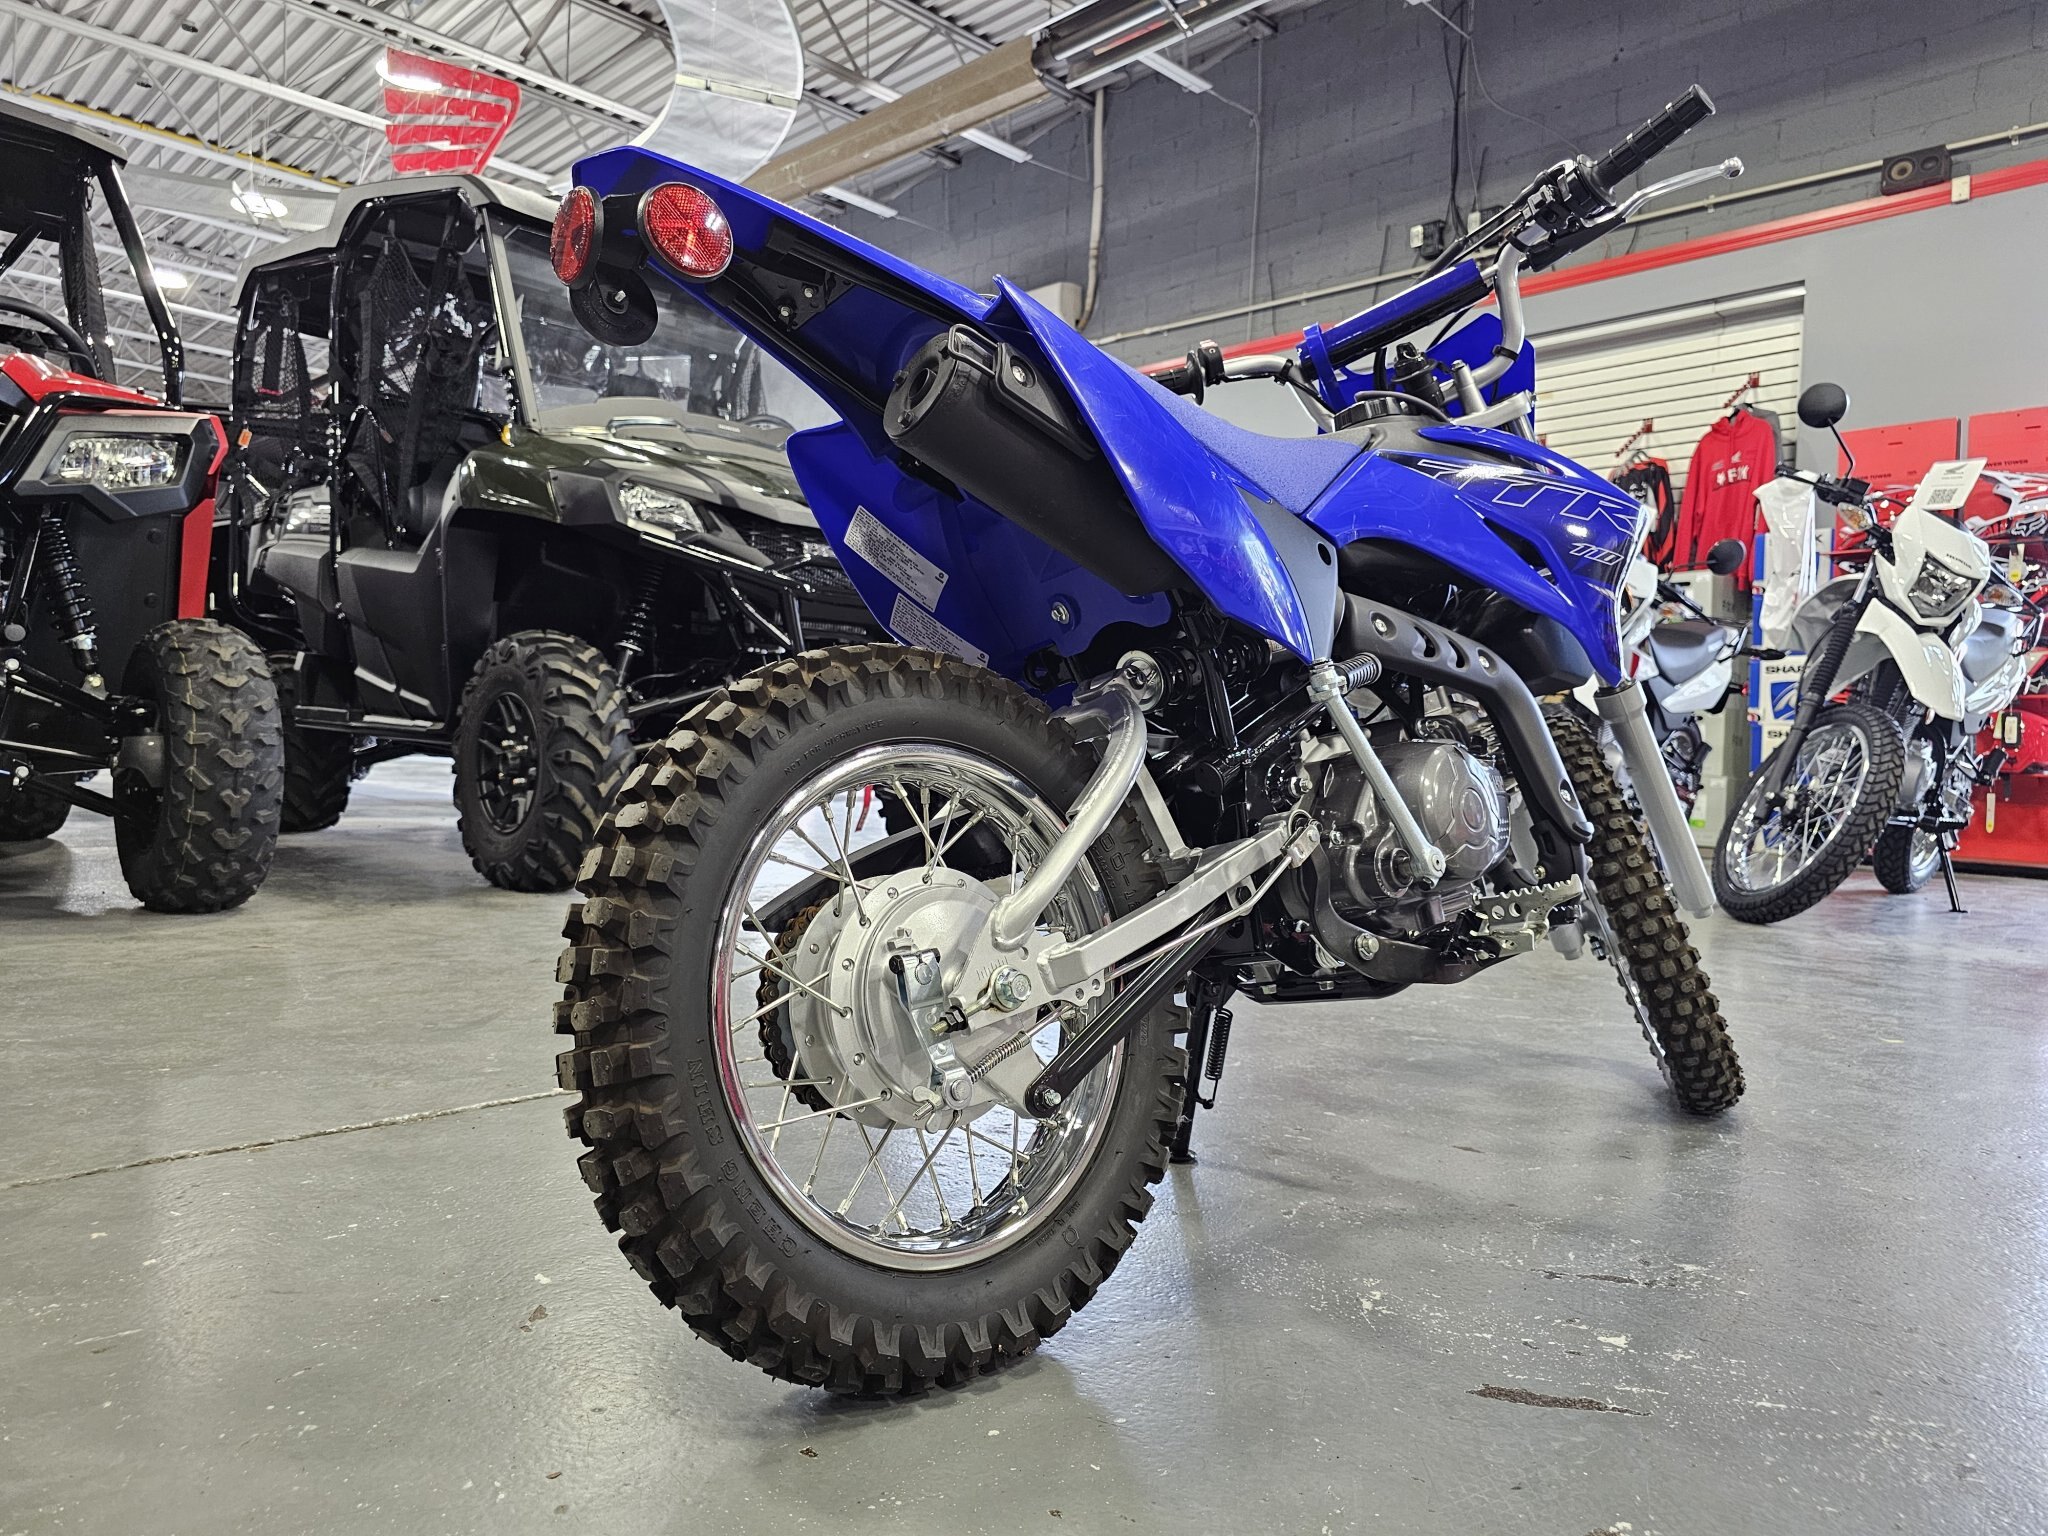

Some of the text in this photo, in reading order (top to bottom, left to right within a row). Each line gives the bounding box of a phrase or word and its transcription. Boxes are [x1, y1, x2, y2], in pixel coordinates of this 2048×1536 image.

[1569, 542, 1625, 565] 110
[784, 758, 801, 775] NOT
[803, 745, 821, 760] FOR
[864, 719, 883, 730] USE
[687, 1058, 798, 1258] CHENG SHIN
